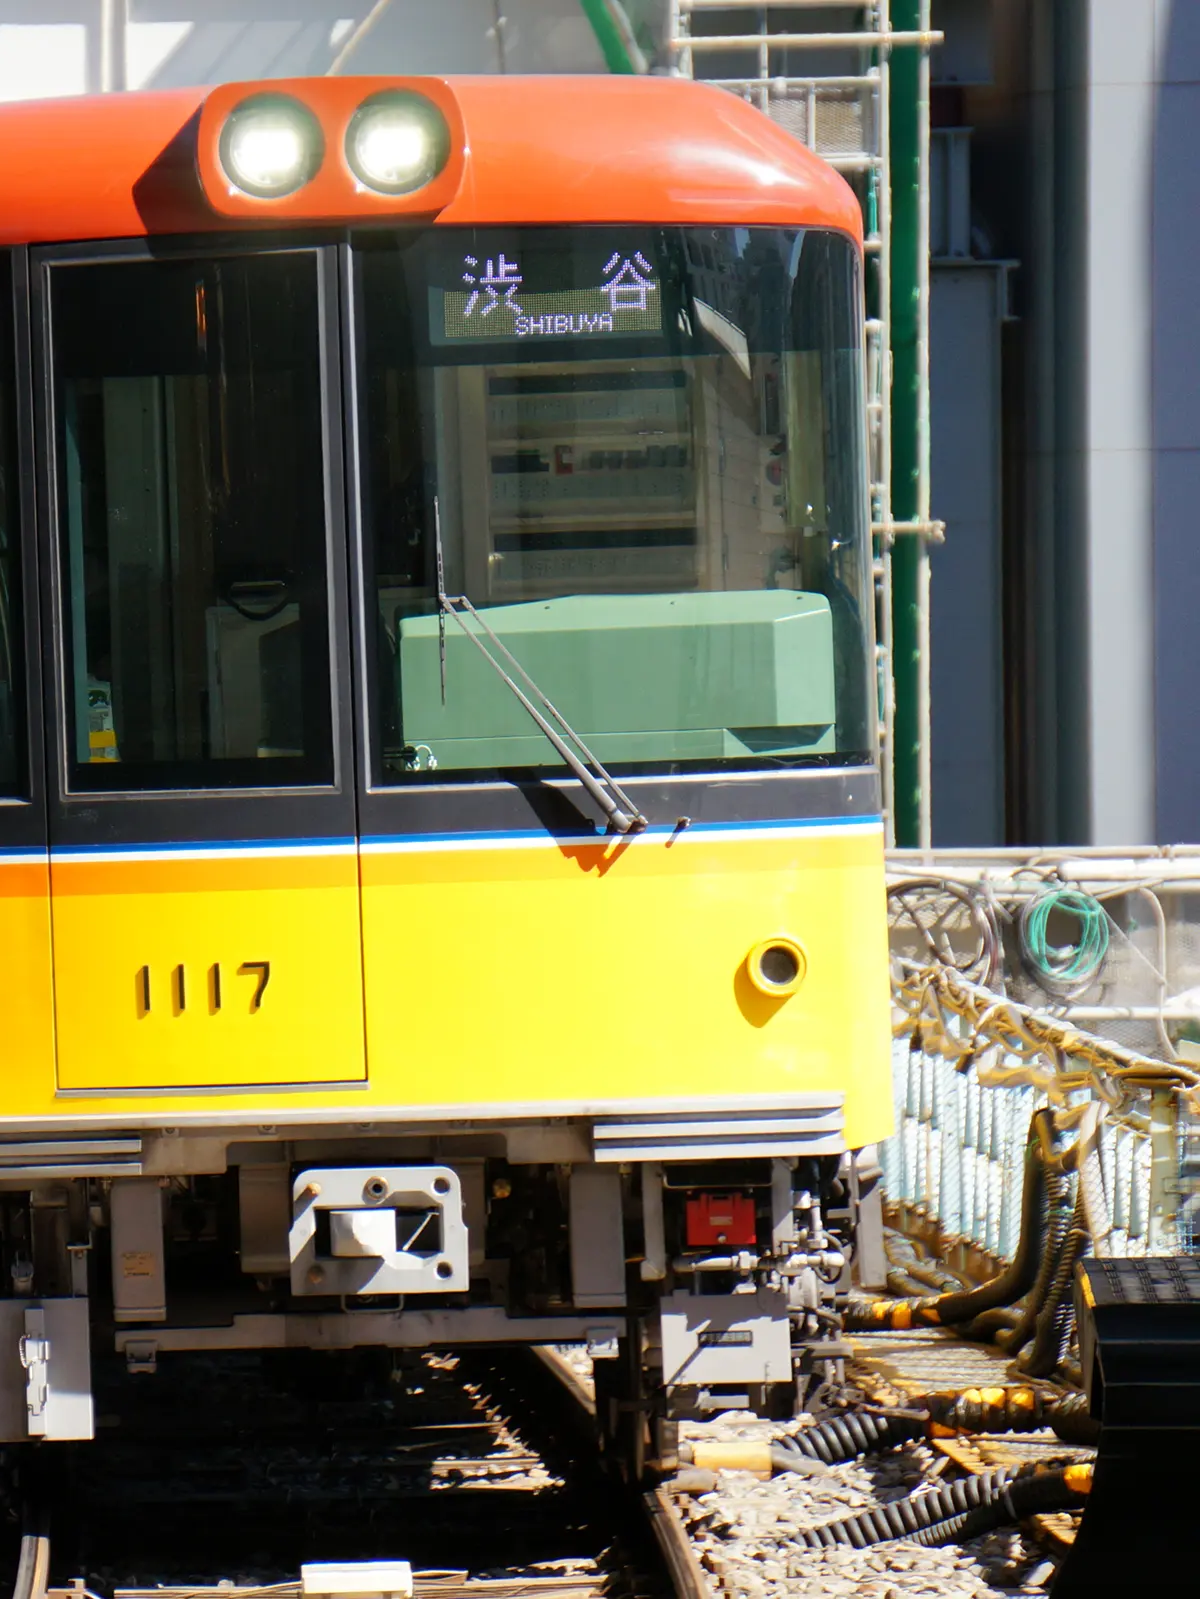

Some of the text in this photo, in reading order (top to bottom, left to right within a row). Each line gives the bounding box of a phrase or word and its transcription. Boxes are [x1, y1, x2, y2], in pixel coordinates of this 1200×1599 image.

[462, 251, 656, 317] 渋谷
[515, 312, 613, 336] SHIBUYA
[138, 960, 271, 1014] 1117
